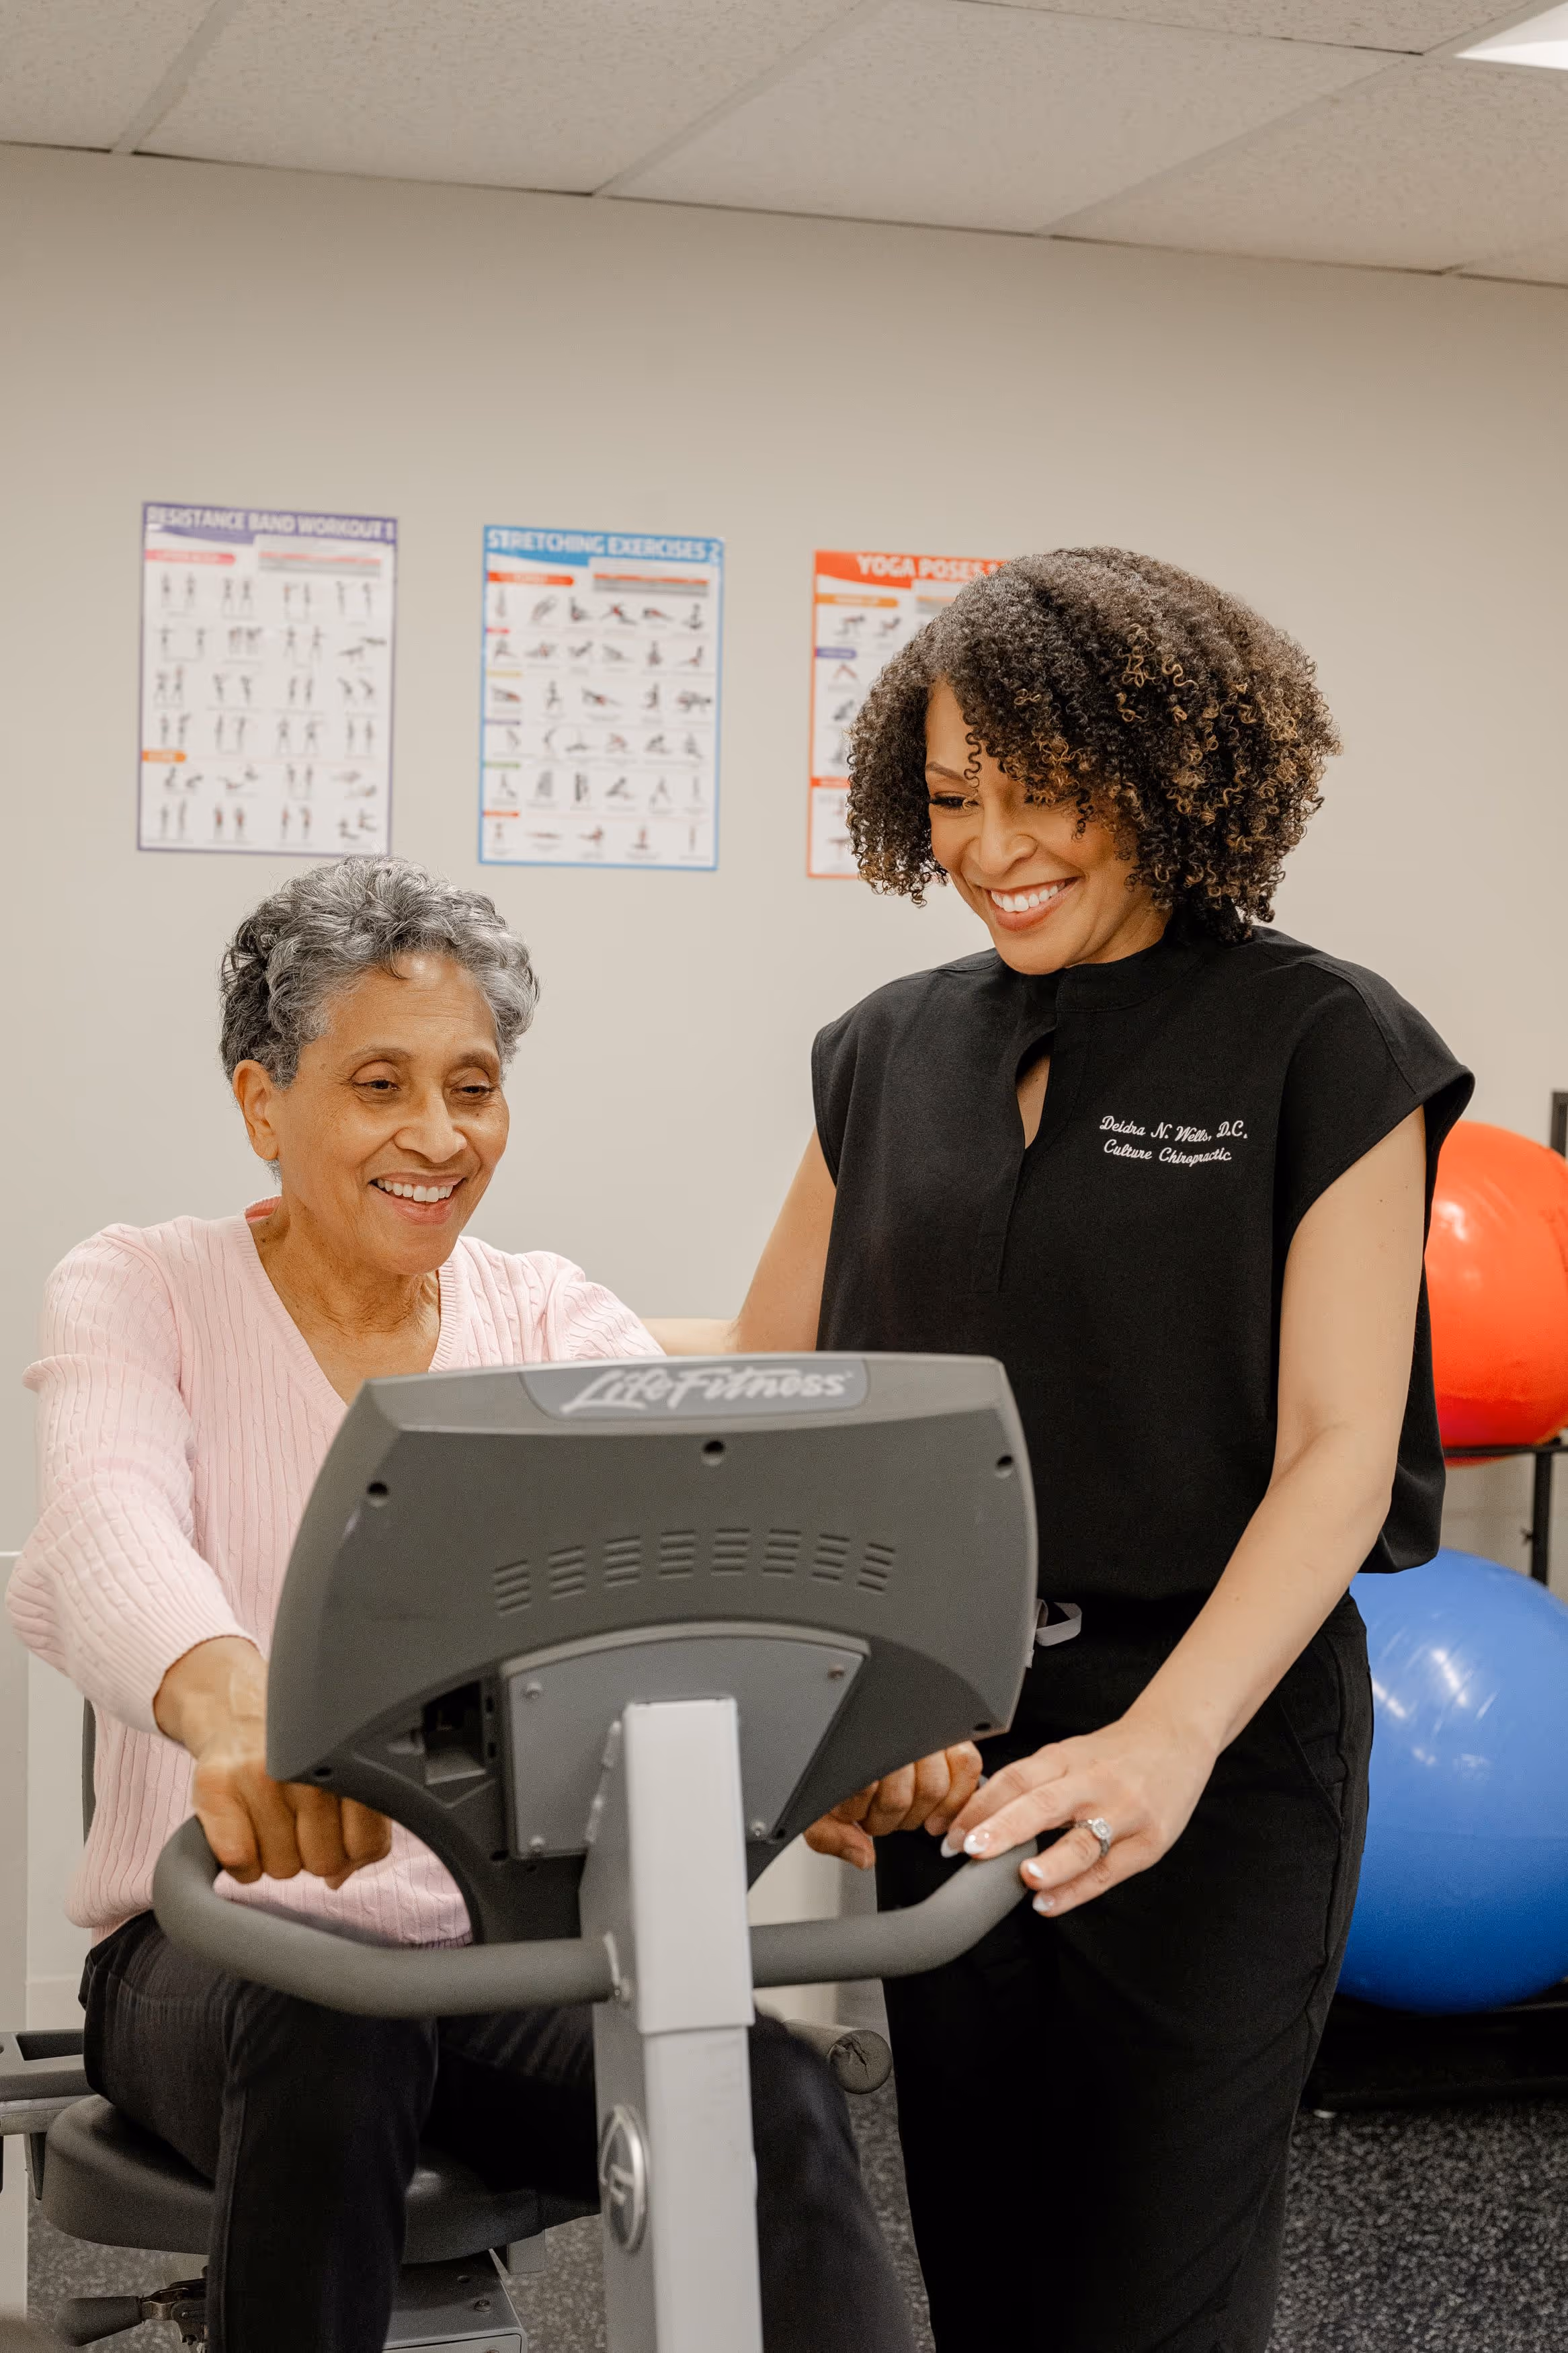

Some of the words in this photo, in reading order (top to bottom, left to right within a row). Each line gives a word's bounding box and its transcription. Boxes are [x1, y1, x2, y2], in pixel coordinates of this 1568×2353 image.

[248, 512, 295, 533] BAND
[297, 516, 381, 538] WORKOUT
[487, 528, 604, 554] STRETCHING
[608, 536, 705, 560] EXERCISES
[709, 541, 721, 561] 2
[857, 554, 915, 577] YOGA
[1100, 1115, 1145, 1135] Deidra
[1151, 1122, 1172, 1138] N.
[1175, 1126, 1211, 1142] Wells,
[1216, 1120, 1247, 1139] D.C.
[1104, 1139, 1152, 1159] Culture
[1159, 1147, 1231, 1167] Chiropractic
